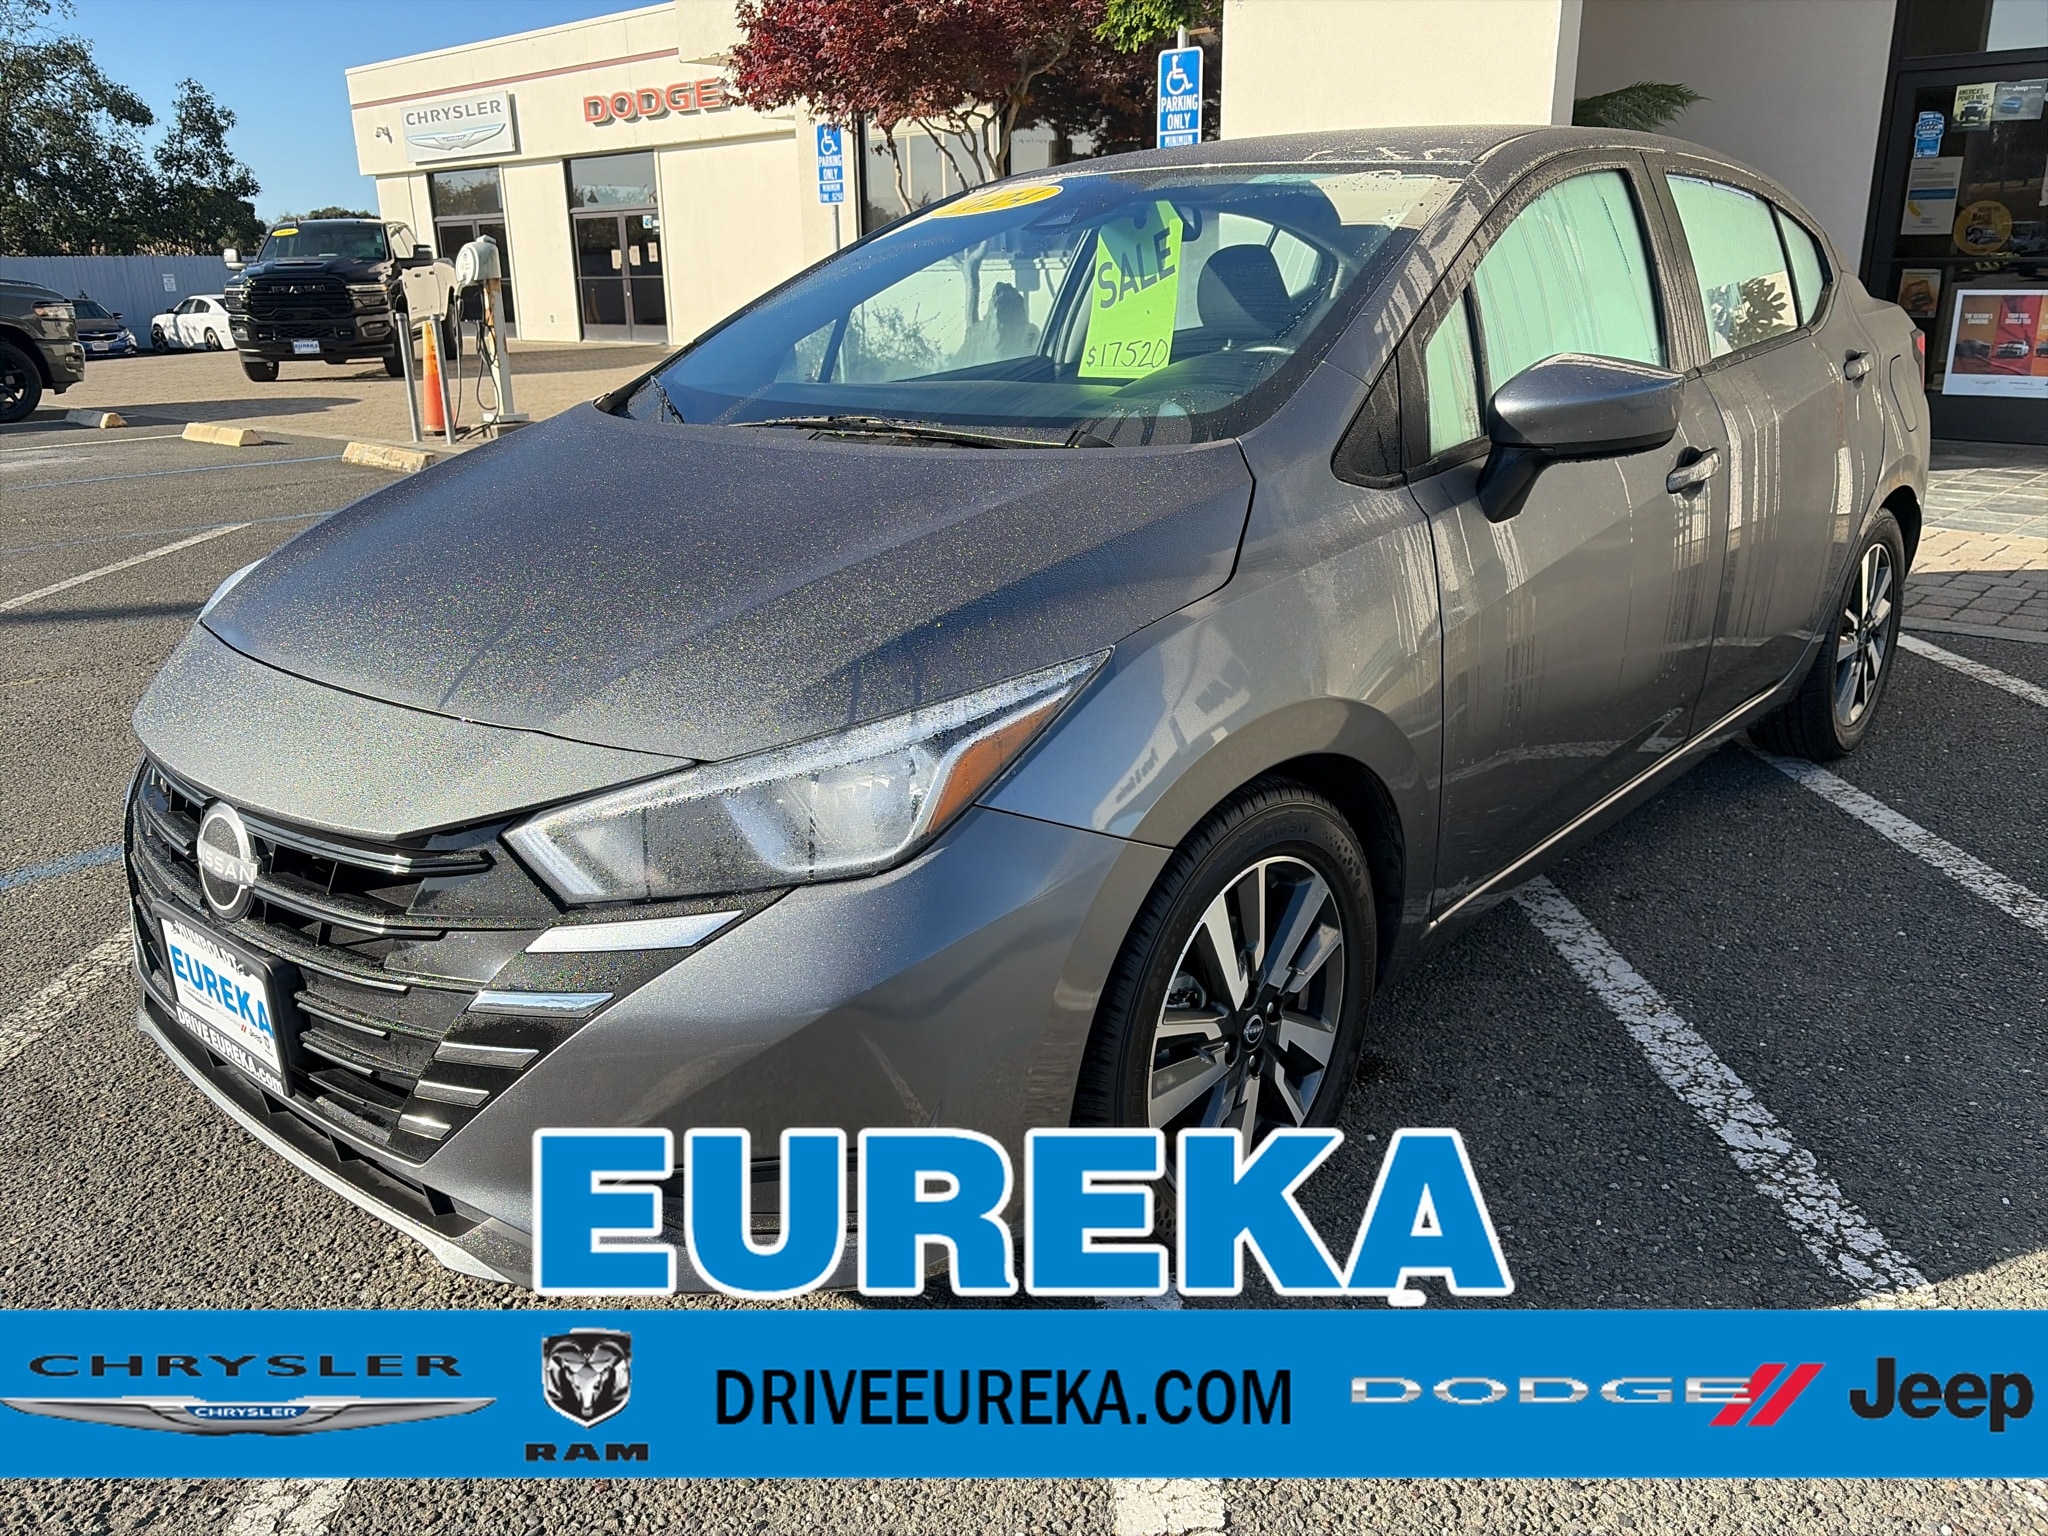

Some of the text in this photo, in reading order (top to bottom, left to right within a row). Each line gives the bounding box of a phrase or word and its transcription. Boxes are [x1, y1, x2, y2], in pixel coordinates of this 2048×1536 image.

[405, 98, 503, 126] CHRYSLER
[583, 78, 722, 123] DODGE
[1161, 94, 1198, 113] PARKING
[1167, 113, 1191, 130] ONLY
[1165, 134, 1193, 147] MINIMUM
[818, 155, 842, 168] PARKING
[823, 168, 838, 180] ONLY
[1097, 228, 1176, 309] SALE
[1087, 338, 1169, 368] $17520
[197, 842, 256, 885] NISSAN
[169, 944, 273, 1040] EUREKA
[176, 1005, 284, 1096] DRIVEEUREKA.com
